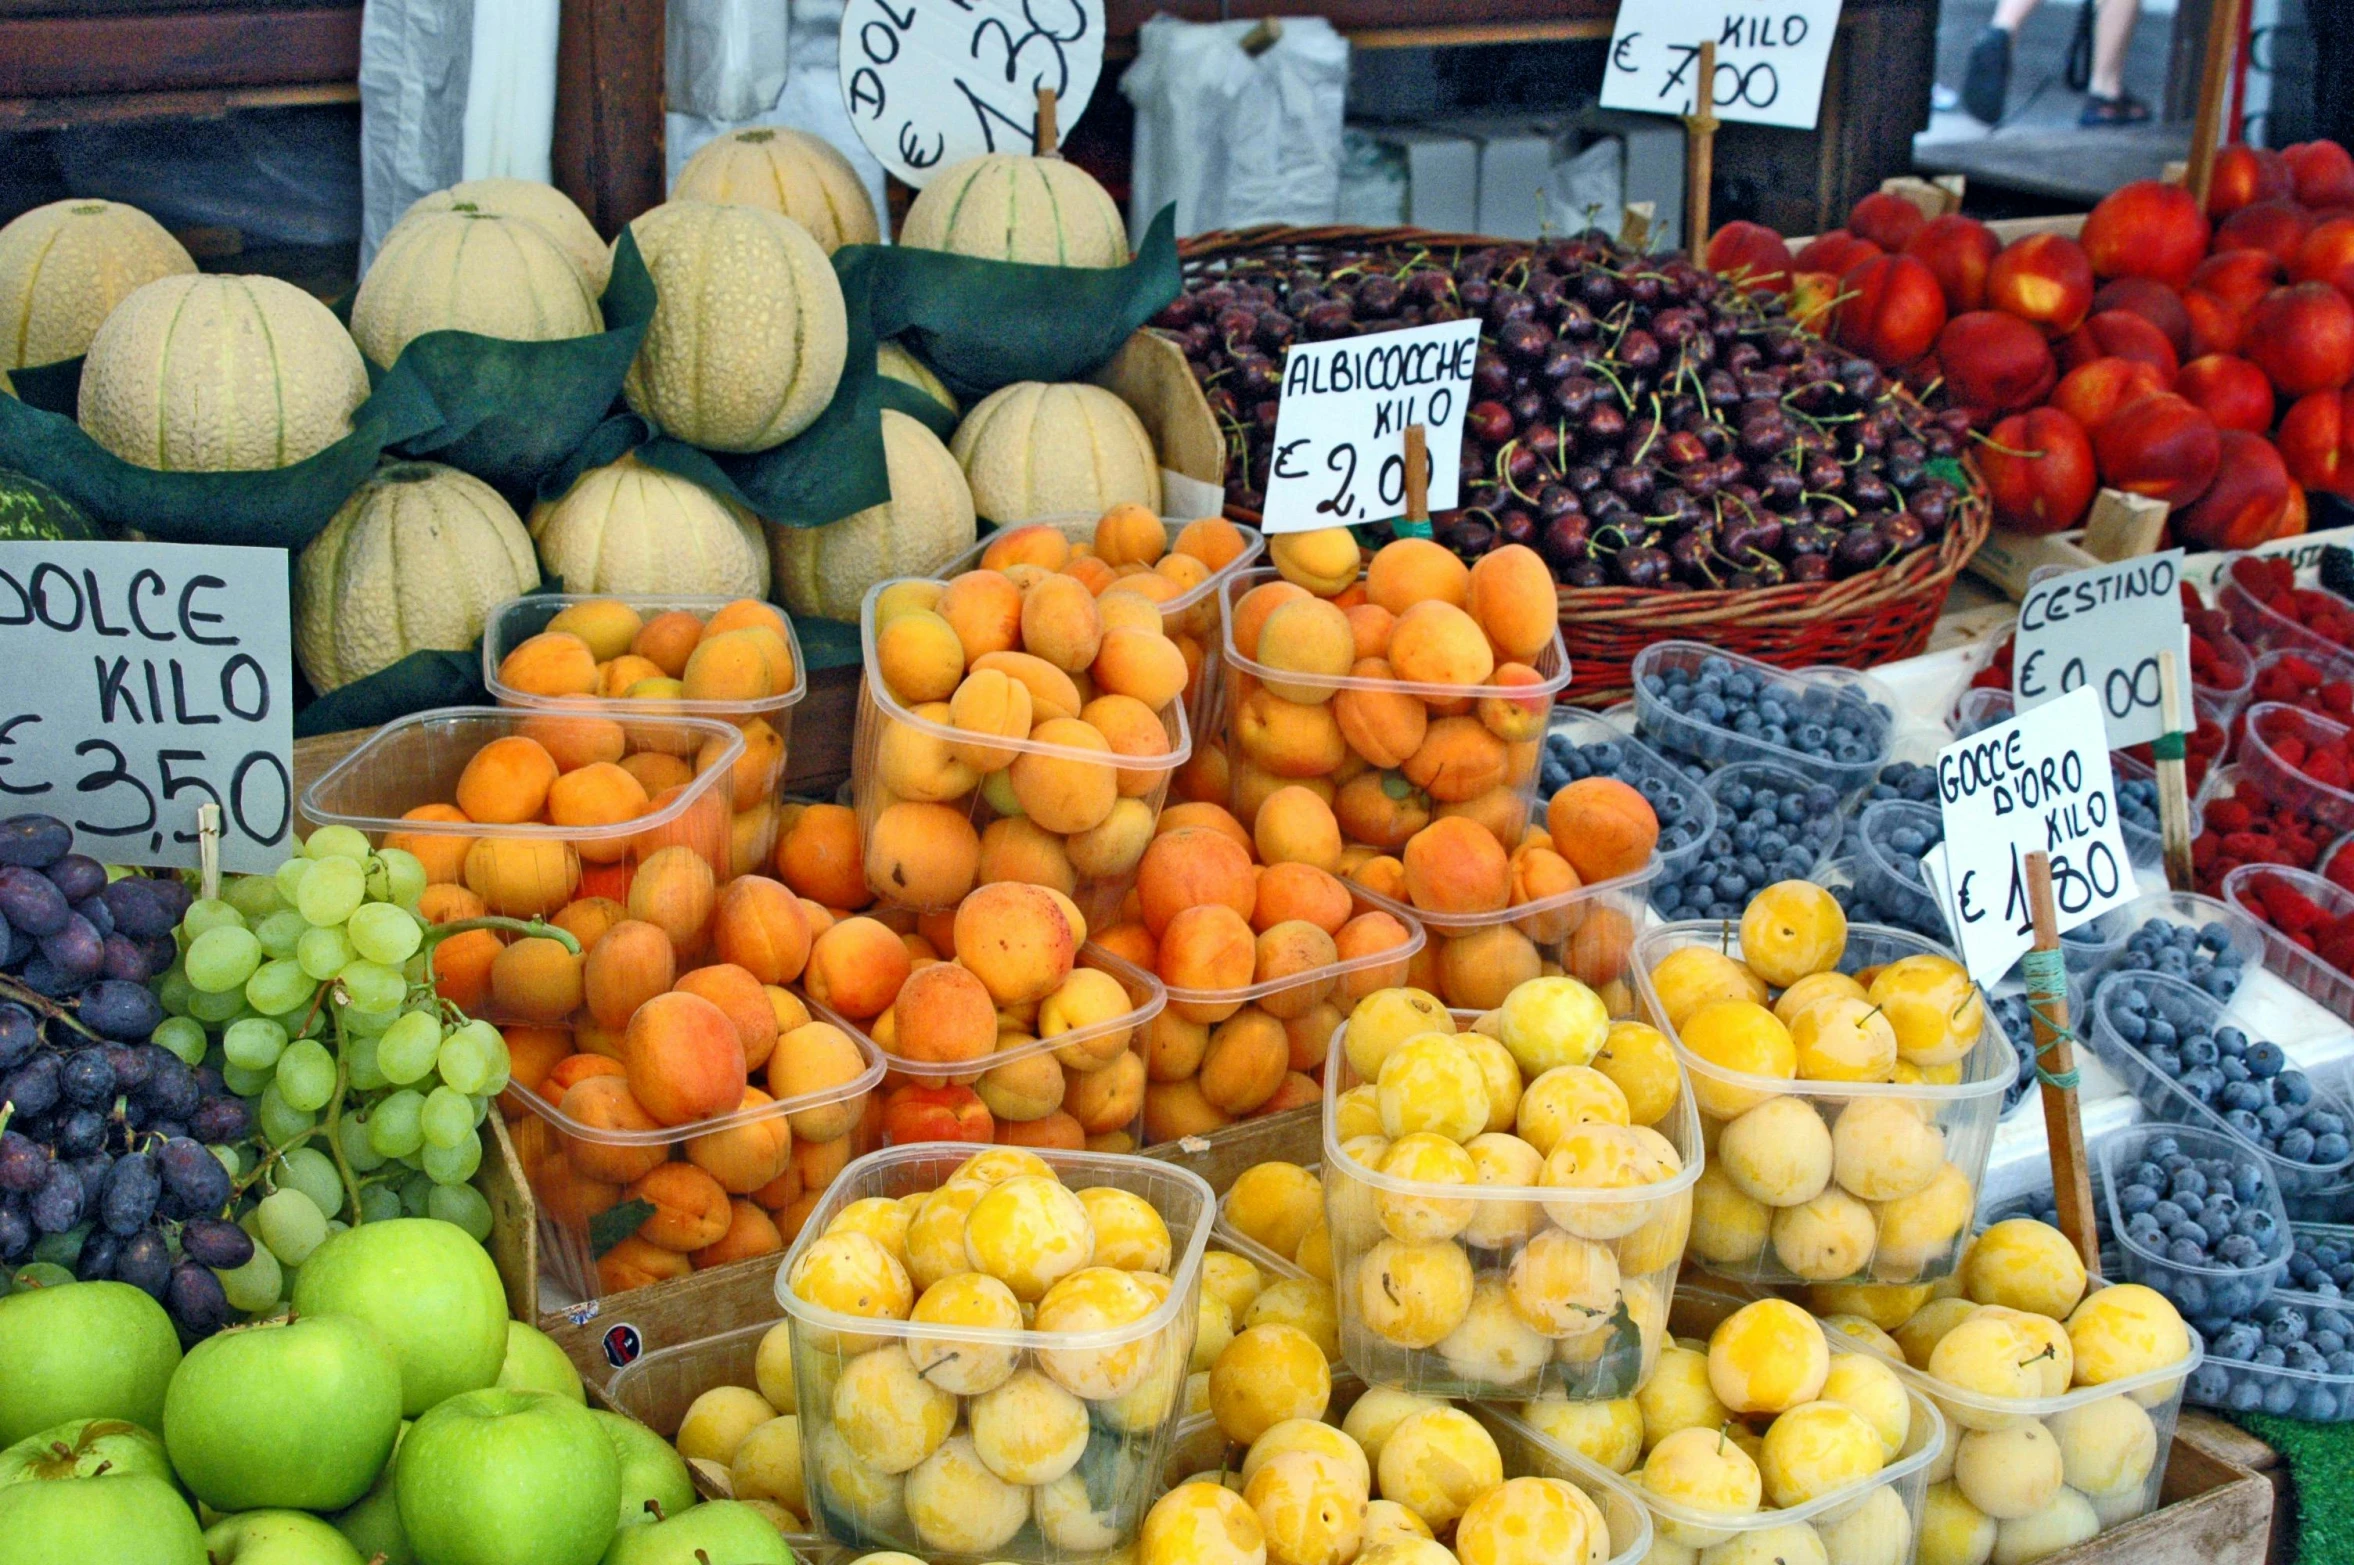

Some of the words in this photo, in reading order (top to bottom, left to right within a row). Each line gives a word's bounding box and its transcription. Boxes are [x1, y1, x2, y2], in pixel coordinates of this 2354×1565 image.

[1719, 15, 1808, 48] KILO
[1613, 32, 1642, 72] €
[1658, 44, 1779, 116] 7,00
[899, 120, 944, 168] €
[1287, 337, 1476, 397] ALBICOCCHE
[1274, 439, 1312, 479] €
[2022, 560, 2174, 632] CESTINO
[95, 653, 270, 724] KILO
[2020, 650, 2046, 697] €
[75, 739, 290, 853] 3,50
[1939, 730, 2024, 803] GOCCE
[1994, 750, 2082, 816] D'ORO
[2045, 791, 2106, 851] KILO
[1958, 870, 1985, 923] €
[2005, 841, 2118, 936] 180
